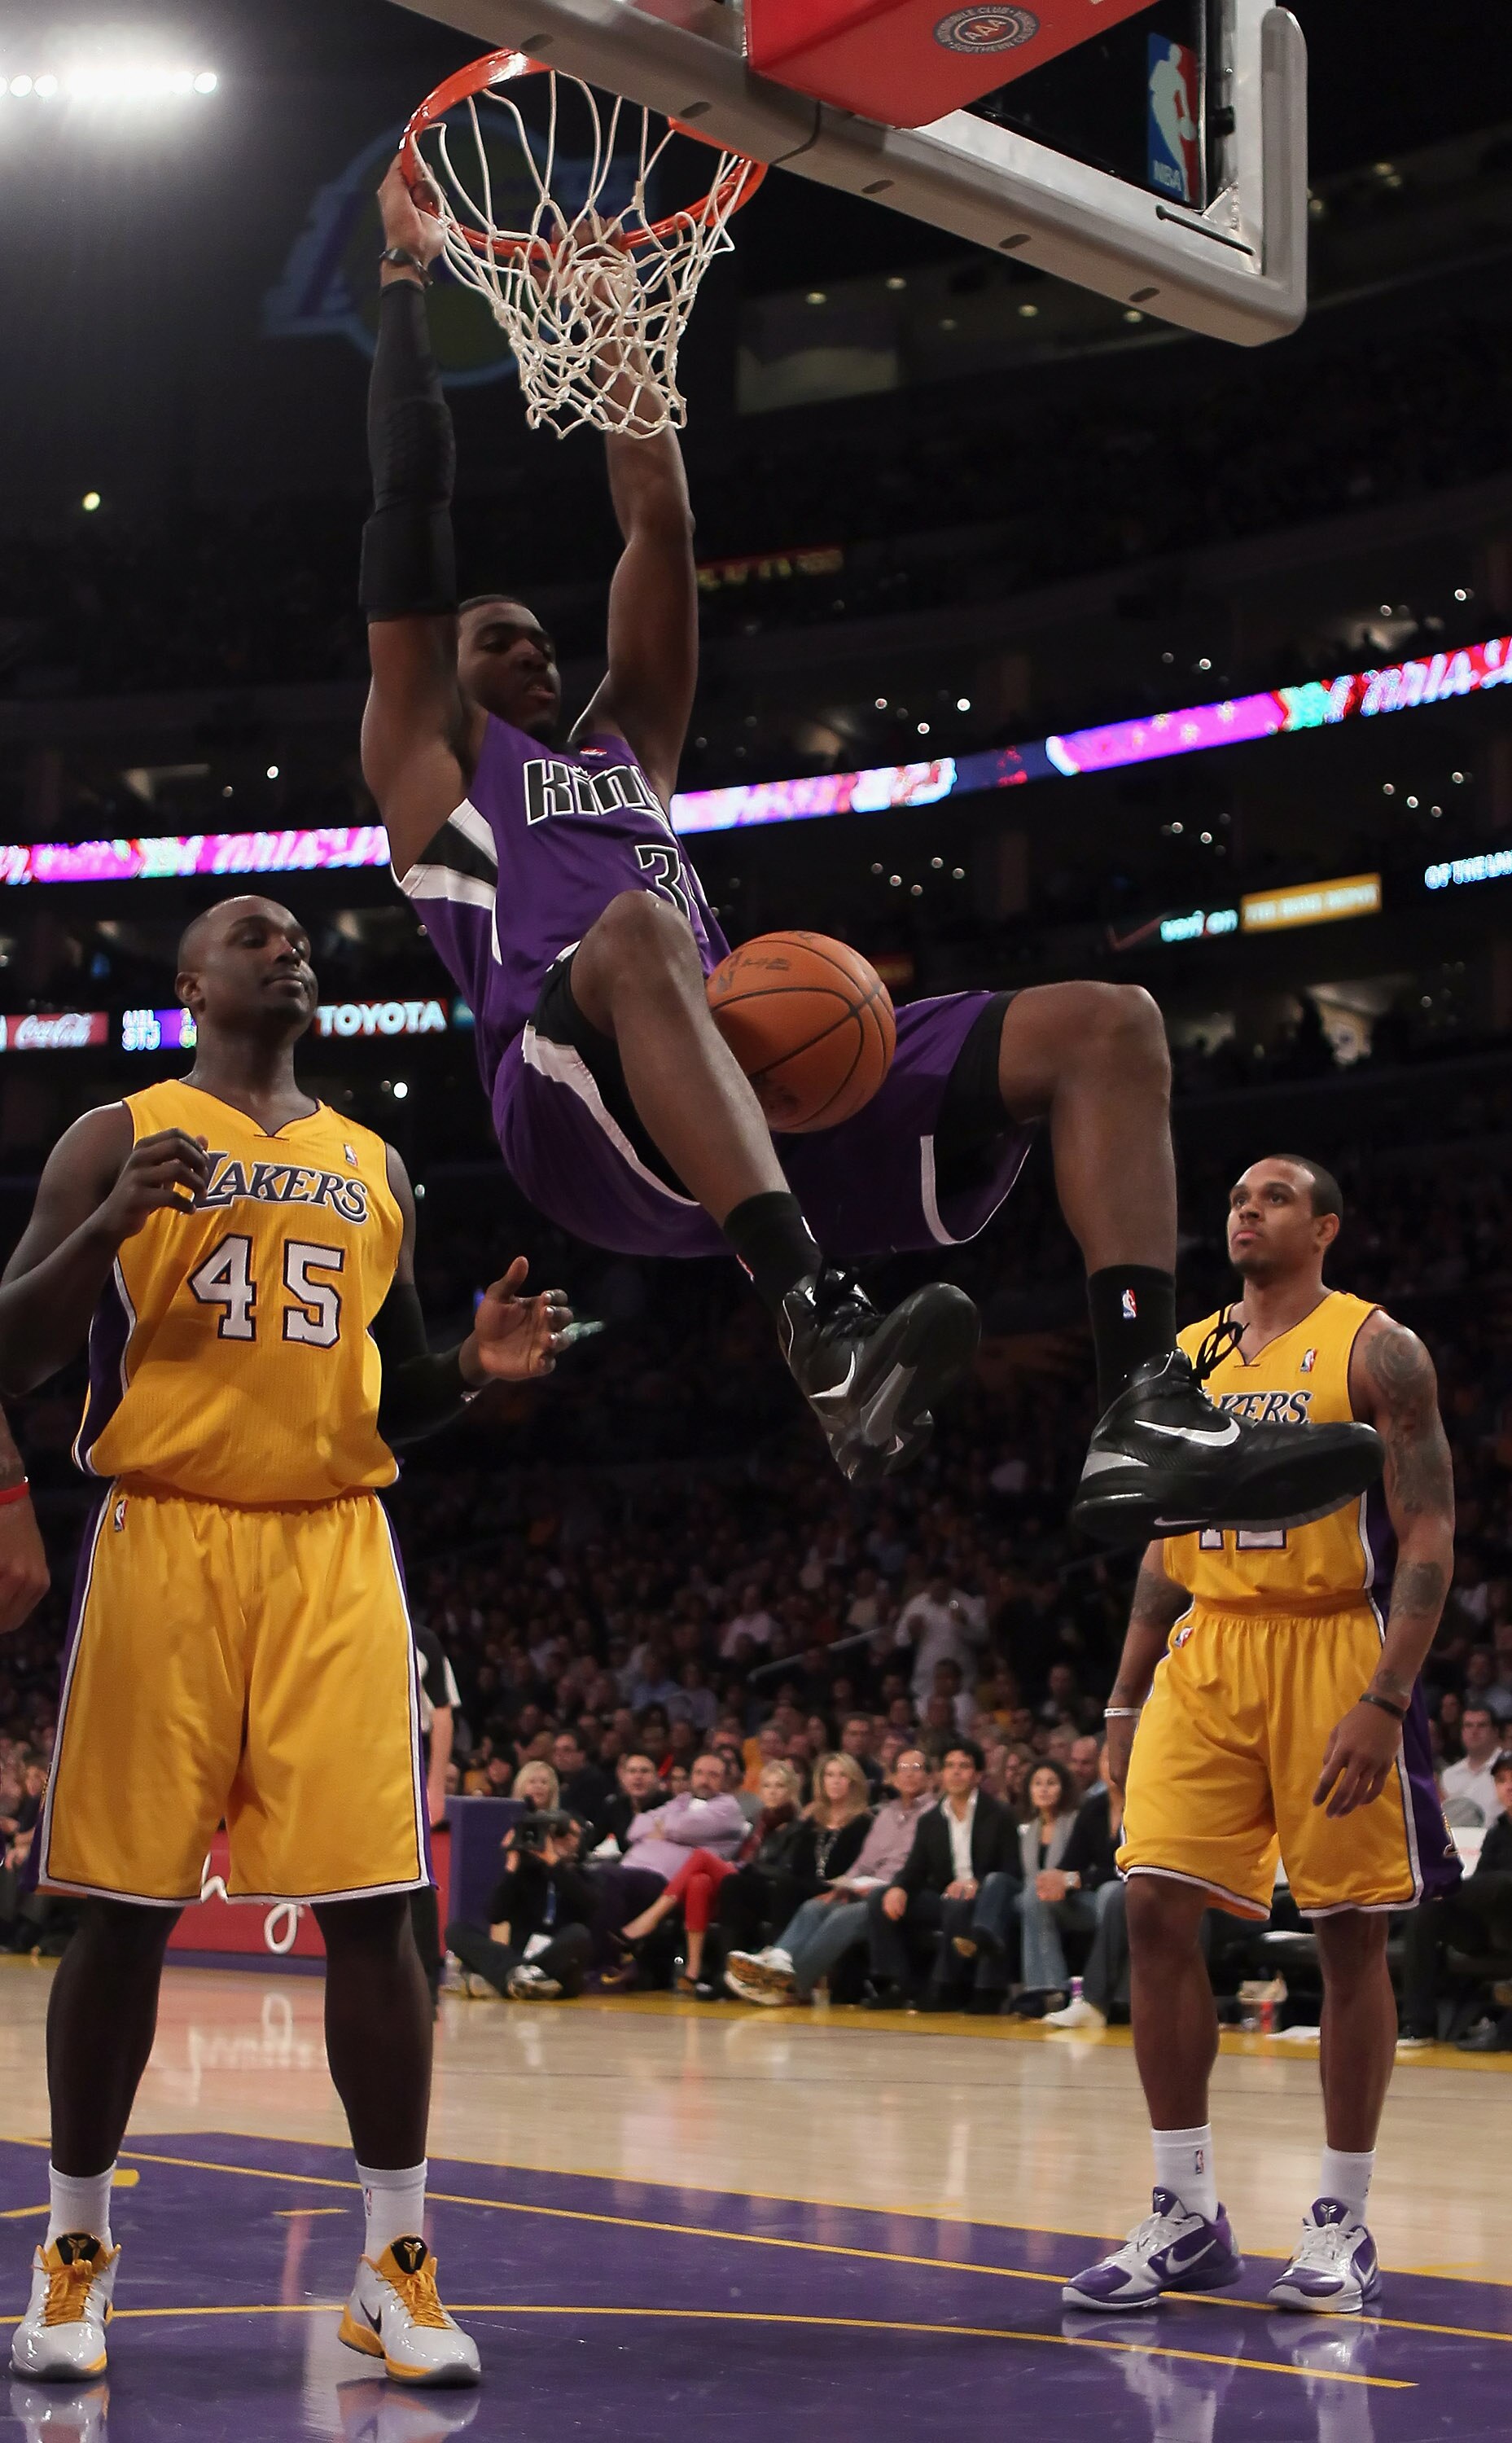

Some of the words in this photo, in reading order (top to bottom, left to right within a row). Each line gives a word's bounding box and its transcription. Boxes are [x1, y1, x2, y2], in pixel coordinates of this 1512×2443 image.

[965, 18, 1007, 41] AAA
[1153, 160, 1182, 191] NBA
[316, 1000, 447, 1037] TOYOTA
[189, 1151, 370, 1225] LAKERS
[187, 1233, 345, 1349] 45
